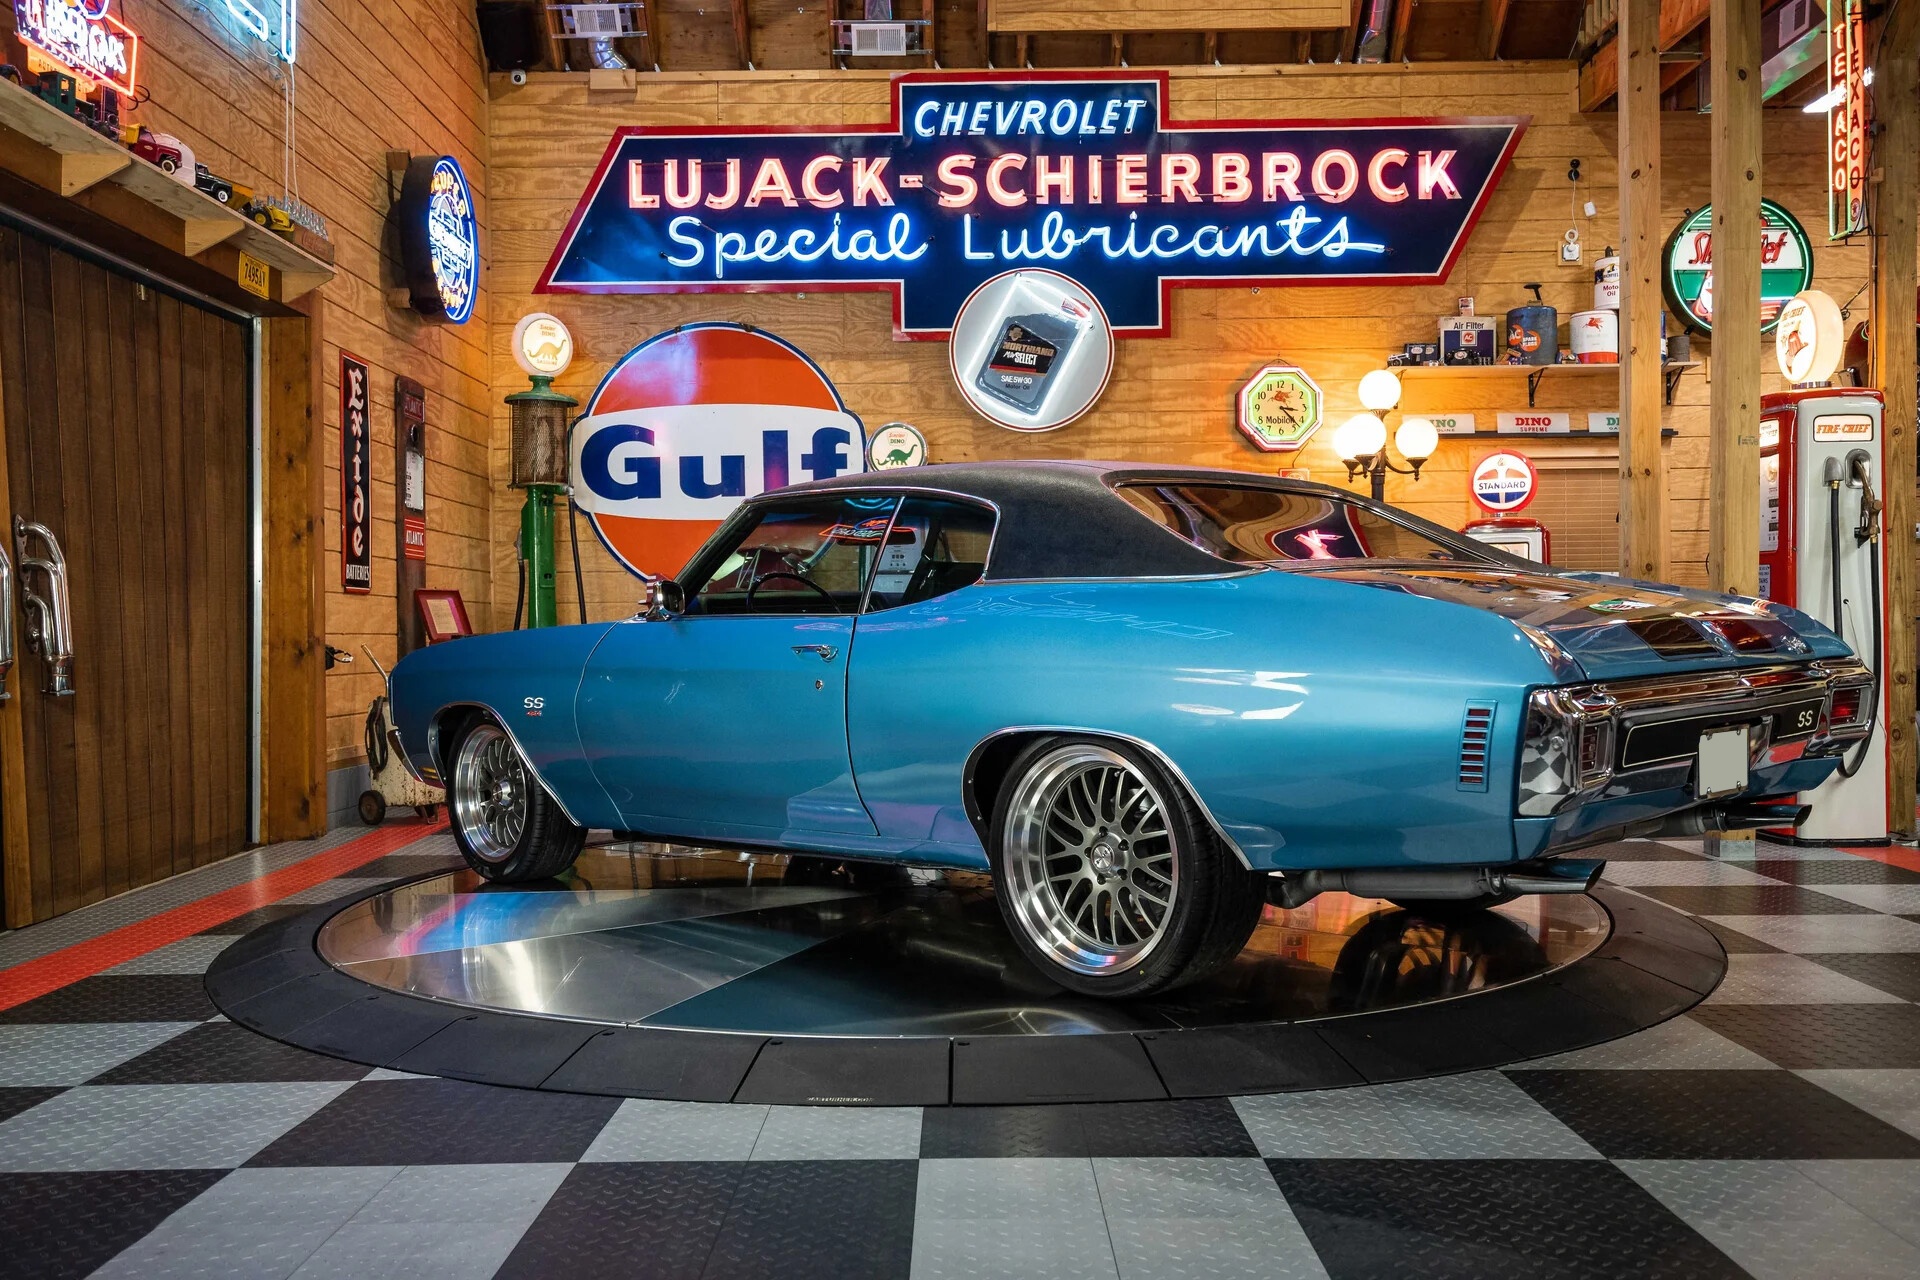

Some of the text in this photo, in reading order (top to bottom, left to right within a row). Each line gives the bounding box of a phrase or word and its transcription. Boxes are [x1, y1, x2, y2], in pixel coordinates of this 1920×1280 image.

[1849, 20, 1860, 190] TEXACO
[914, 99, 1147, 137] CHEVROLET
[963, 204, 1387, 260] Lubricants
[666, 212, 930, 280] Special
[1454, 321, 1484, 330] Air Filter
[1464, 333, 1473, 341] AC
[1014, 351, 1038, 366] SELECT
[1267, 384, 1273, 392] 11
[1277, 381, 1285, 389] 12
[1291, 383, 1295, 391] 1
[1257, 391, 1267, 400] 10
[1299, 391, 1304, 399] 2
[1255, 404, 1260, 412] 9
[1302, 403, 1307, 412] 3
[1258, 416, 1264, 425] 8
[1430, 418, 1457, 428] INO
[1515, 417, 1552, 427] DINO
[1606, 417, 1620, 427] DI
[1267, 425, 1272, 433] 7
[1279, 428, 1284, 436] 6
[1816, 424, 1871, 435] FIRE-CHIEF
[348, 367, 364, 557] Exide
[580, 424, 851, 501] Gulf
[1478, 481, 1526, 490] STANDARD
[405, 530, 424, 547] ATLANTIC
[346, 563, 370, 581] BATTERIES
[523, 696, 545, 709] SS
[1797, 710, 1814, 728] SS
